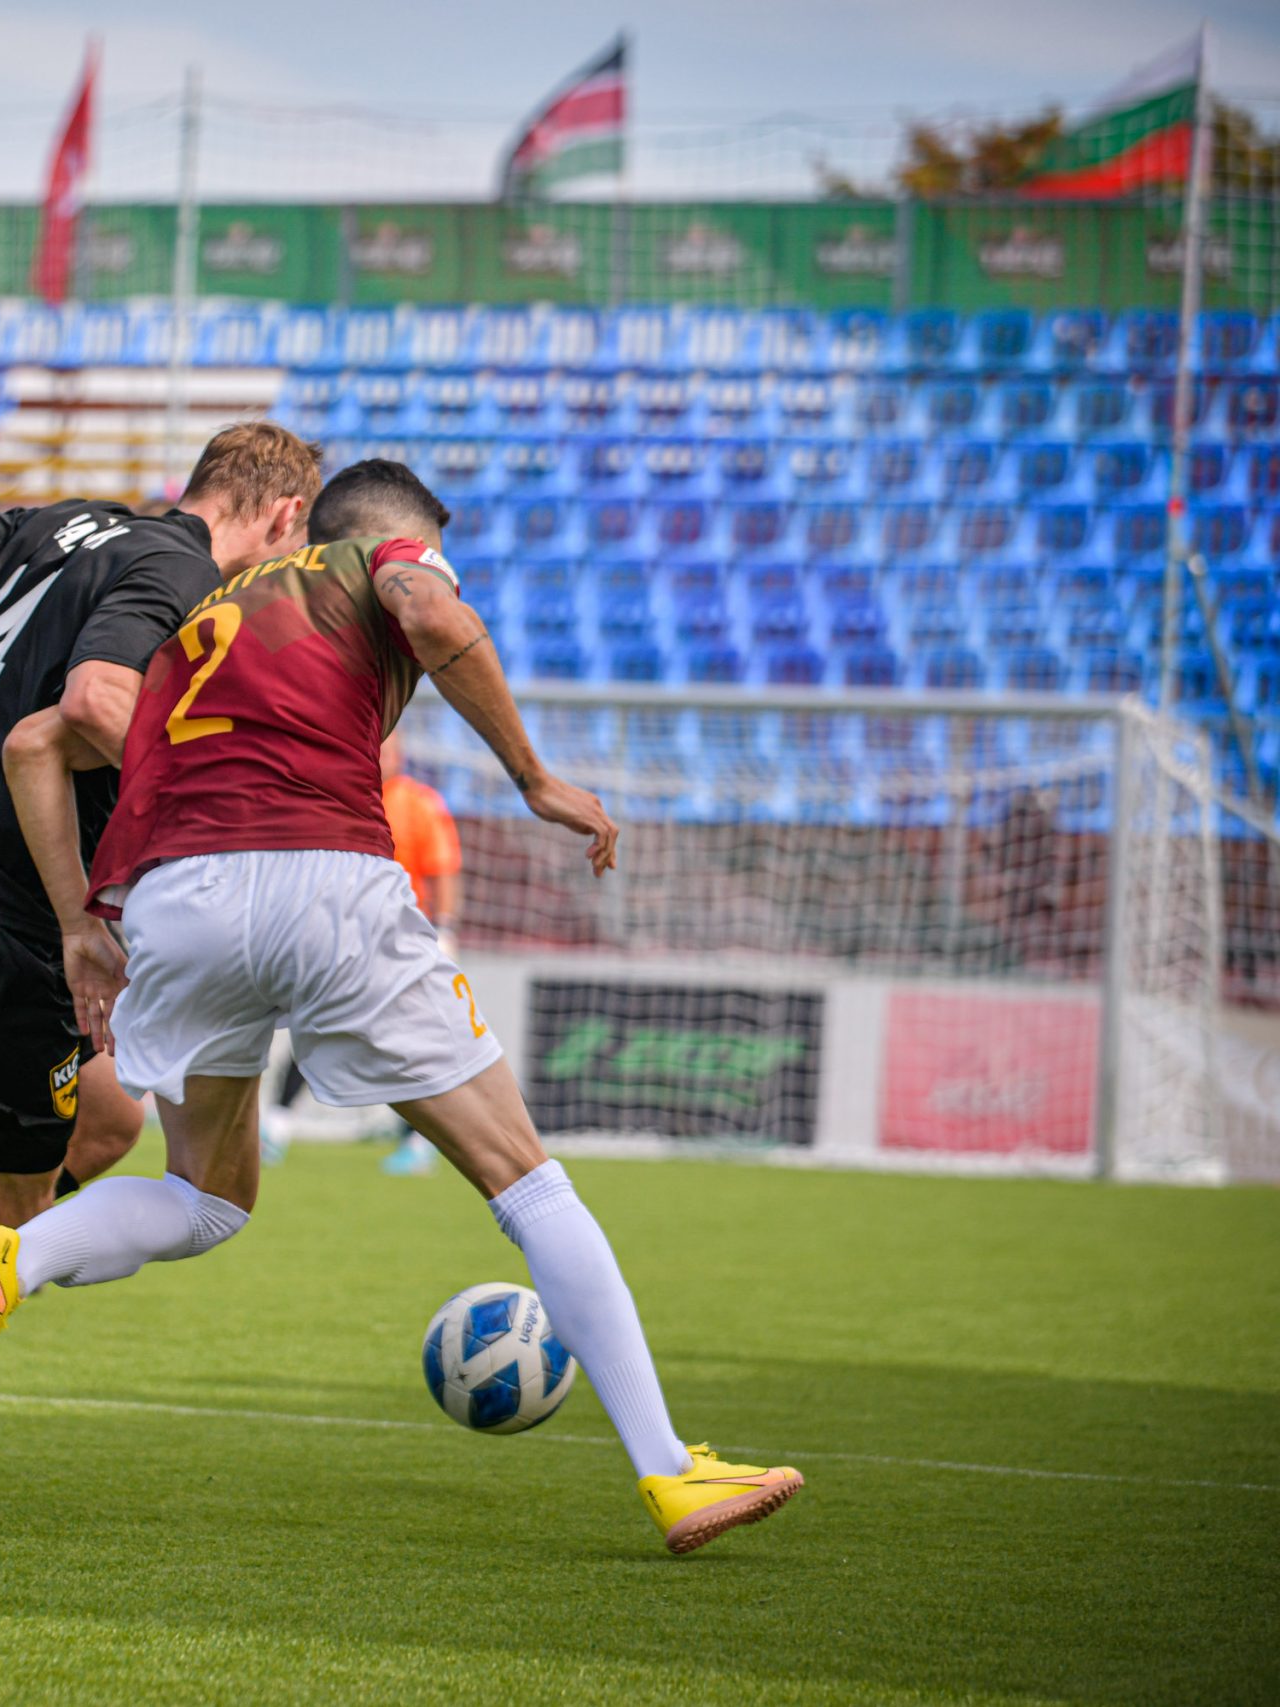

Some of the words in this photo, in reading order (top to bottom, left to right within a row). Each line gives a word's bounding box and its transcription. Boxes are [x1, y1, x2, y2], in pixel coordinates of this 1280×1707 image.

[166, 603, 241, 745] 2
[452, 973, 488, 1039] 2
[518, 1297, 539, 1344] molten
